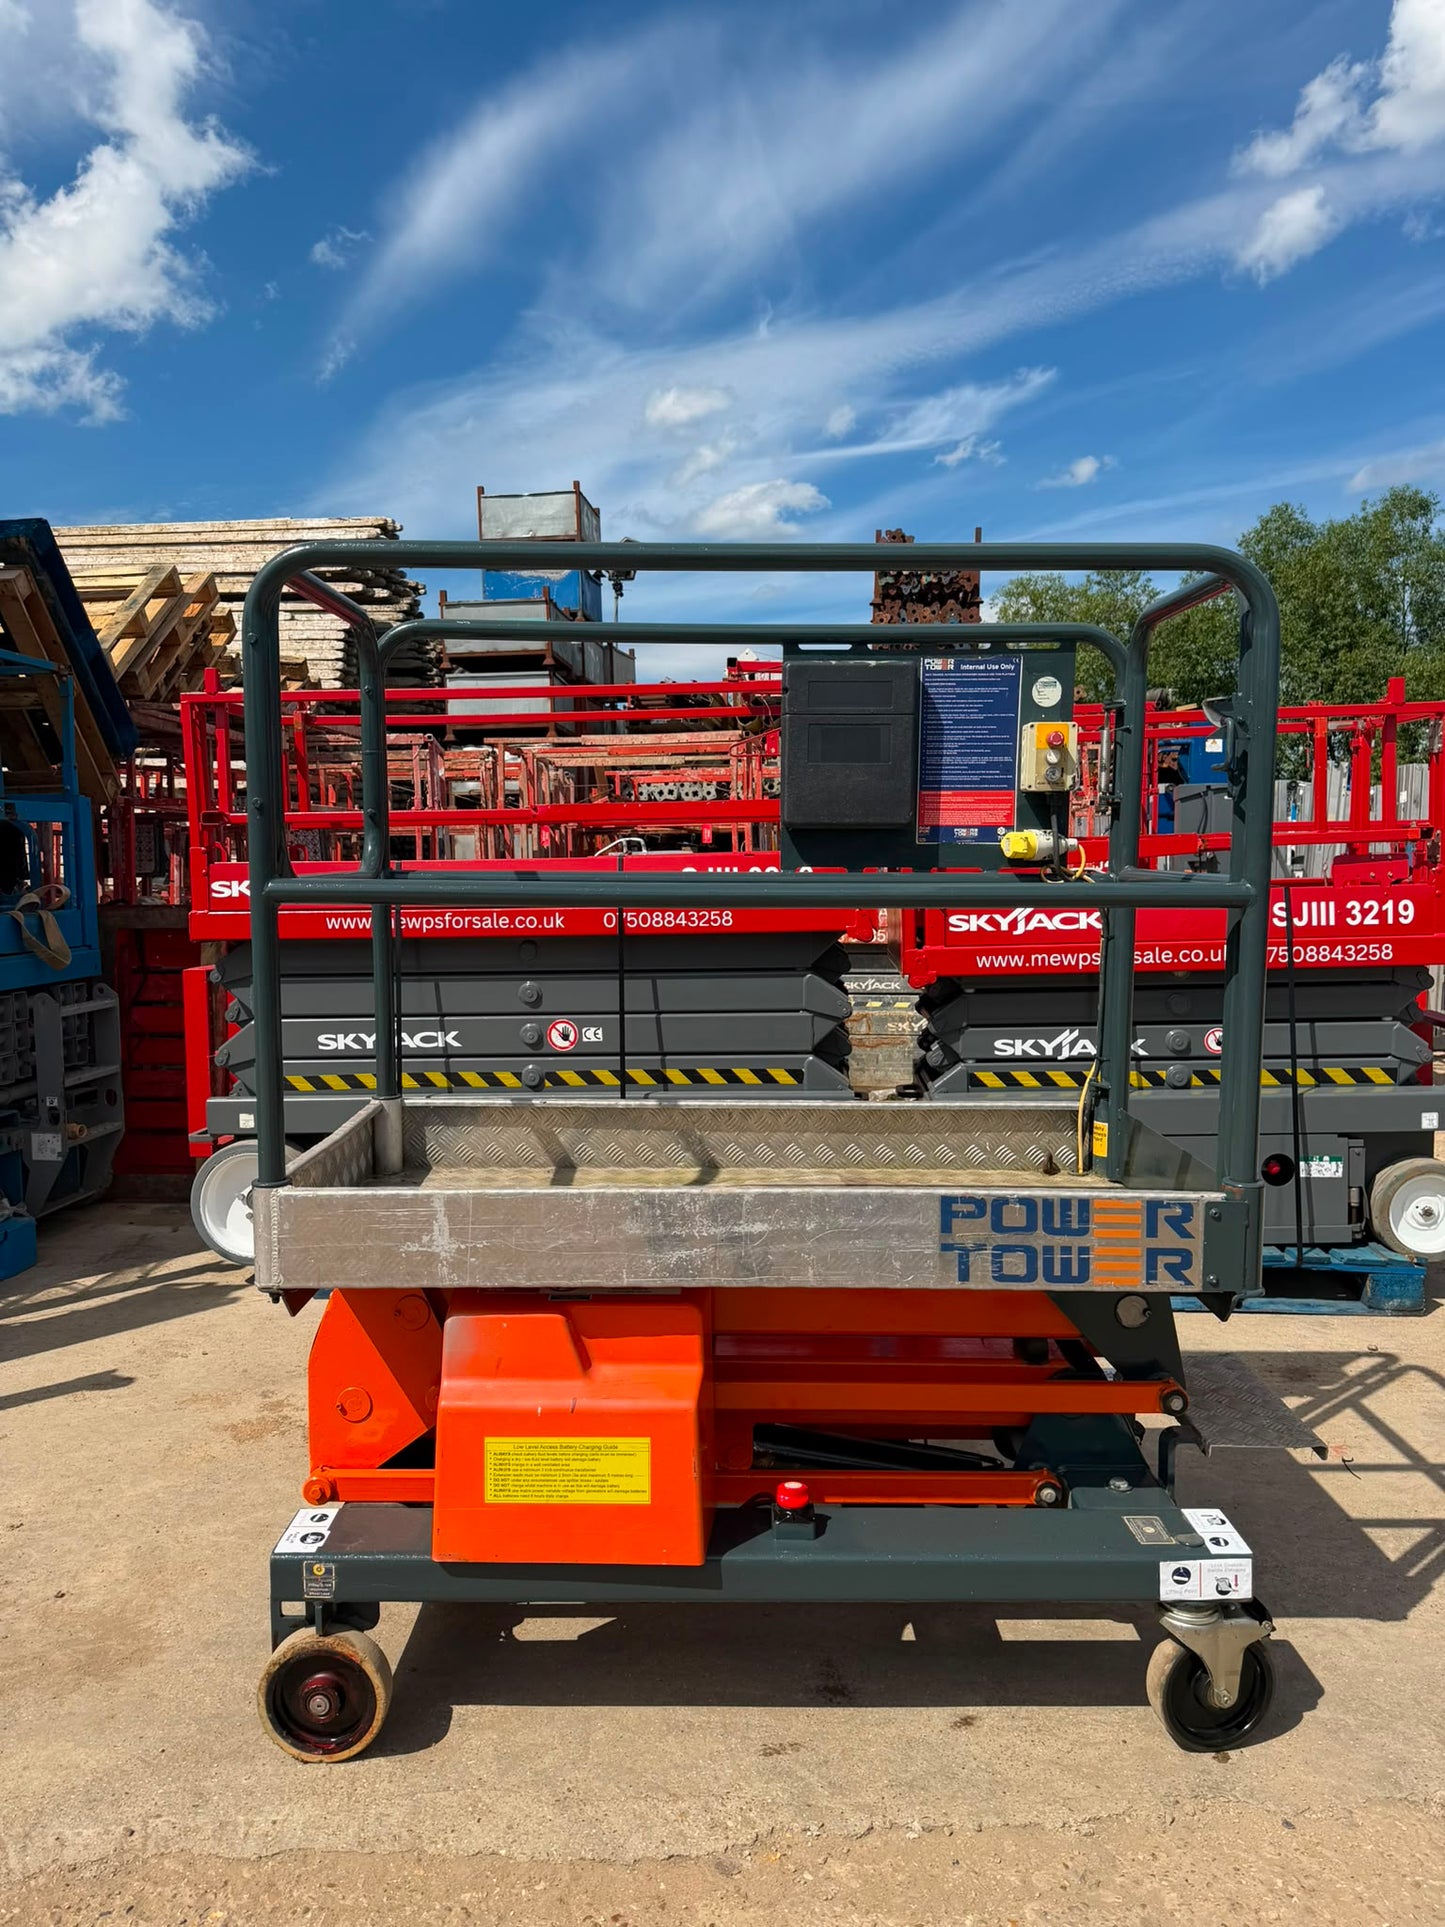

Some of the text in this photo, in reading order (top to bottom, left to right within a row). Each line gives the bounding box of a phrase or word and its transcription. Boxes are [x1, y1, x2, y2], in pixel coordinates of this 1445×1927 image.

[326, 911, 565, 933] wwwewpsforsale.co.uk
[948, 907, 1102, 935] SKYJACK
[1345, 899, 1415, 926] 3219
[976, 944, 1393, 970] www.mewpssale.co.u 7508843258
[317, 1030, 463, 1050] SKYACK
[940, 1195, 1195, 1239] POWER
[940, 1242, 1195, 1287] TOWER
